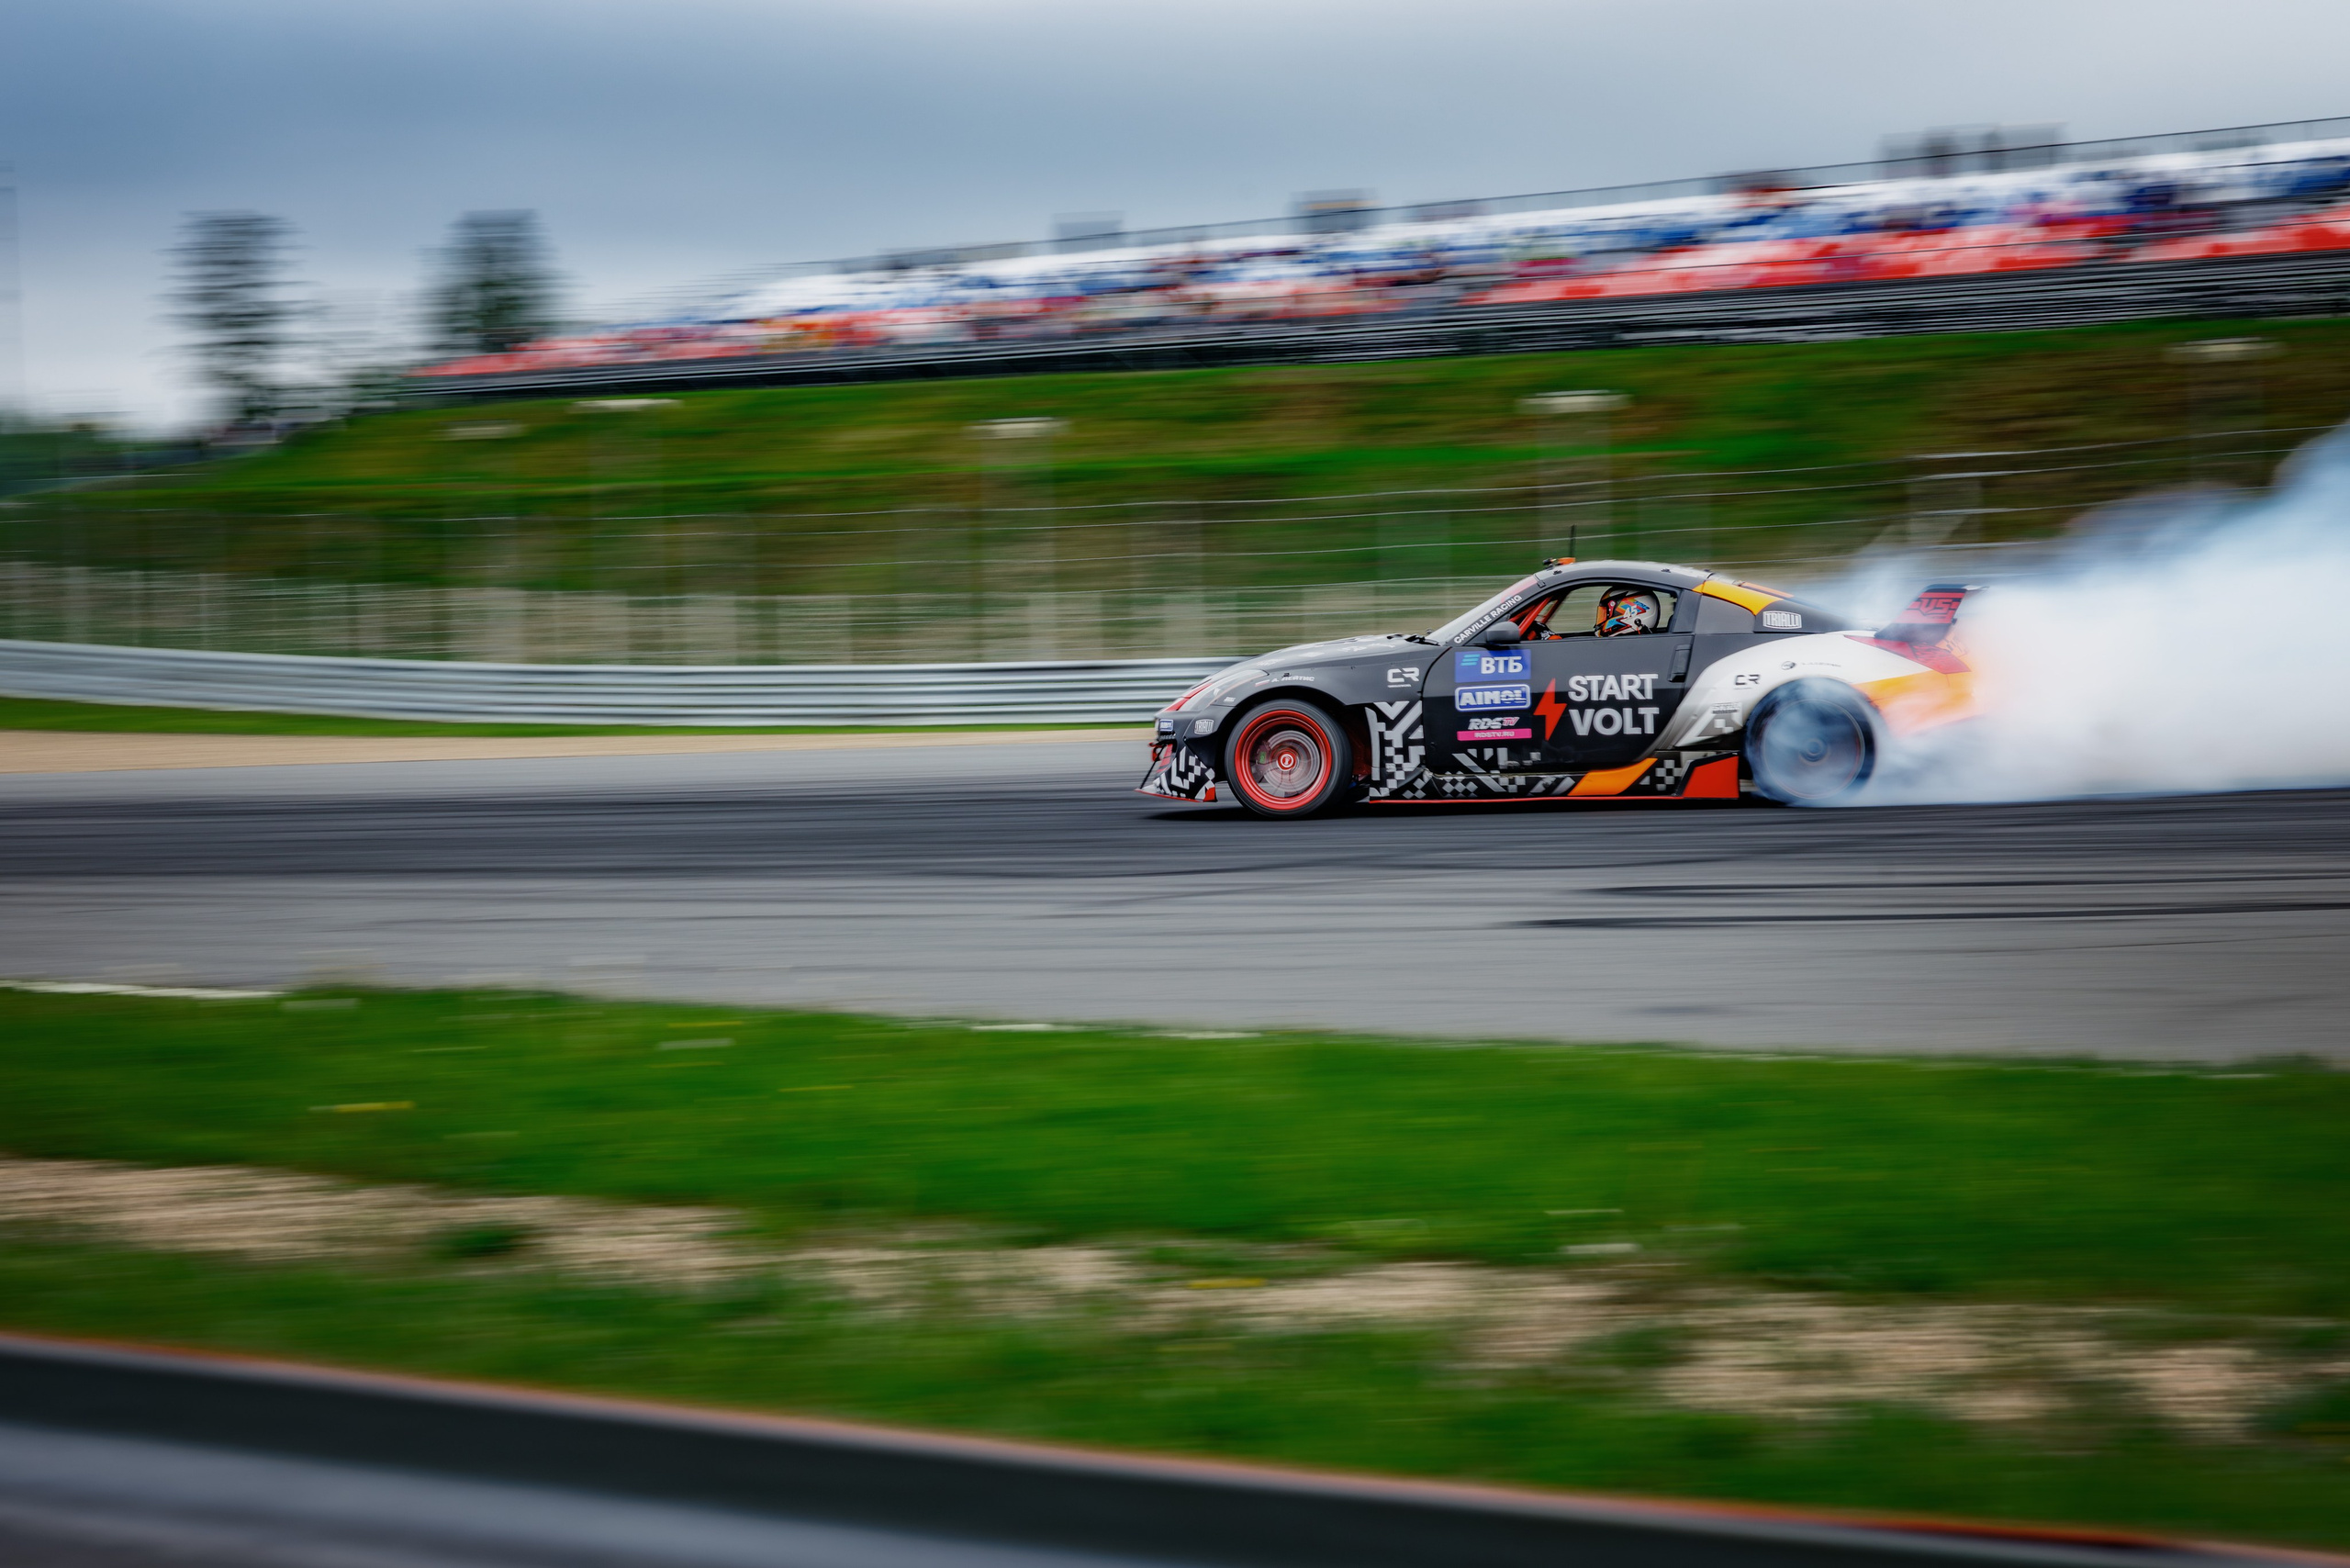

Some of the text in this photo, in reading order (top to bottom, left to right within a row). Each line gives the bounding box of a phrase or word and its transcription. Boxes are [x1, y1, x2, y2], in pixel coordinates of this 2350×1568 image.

[1454, 594, 1523, 644] CARVILLE RACING
[1387, 667, 1420, 683] CR
[1481, 655, 1524, 675] ВТБ
[1568, 674, 1659, 702] START
[1735, 674, 1761, 686] CR
[1459, 689, 1528, 706] AIMOL
[1568, 707, 1660, 735] VOLT
